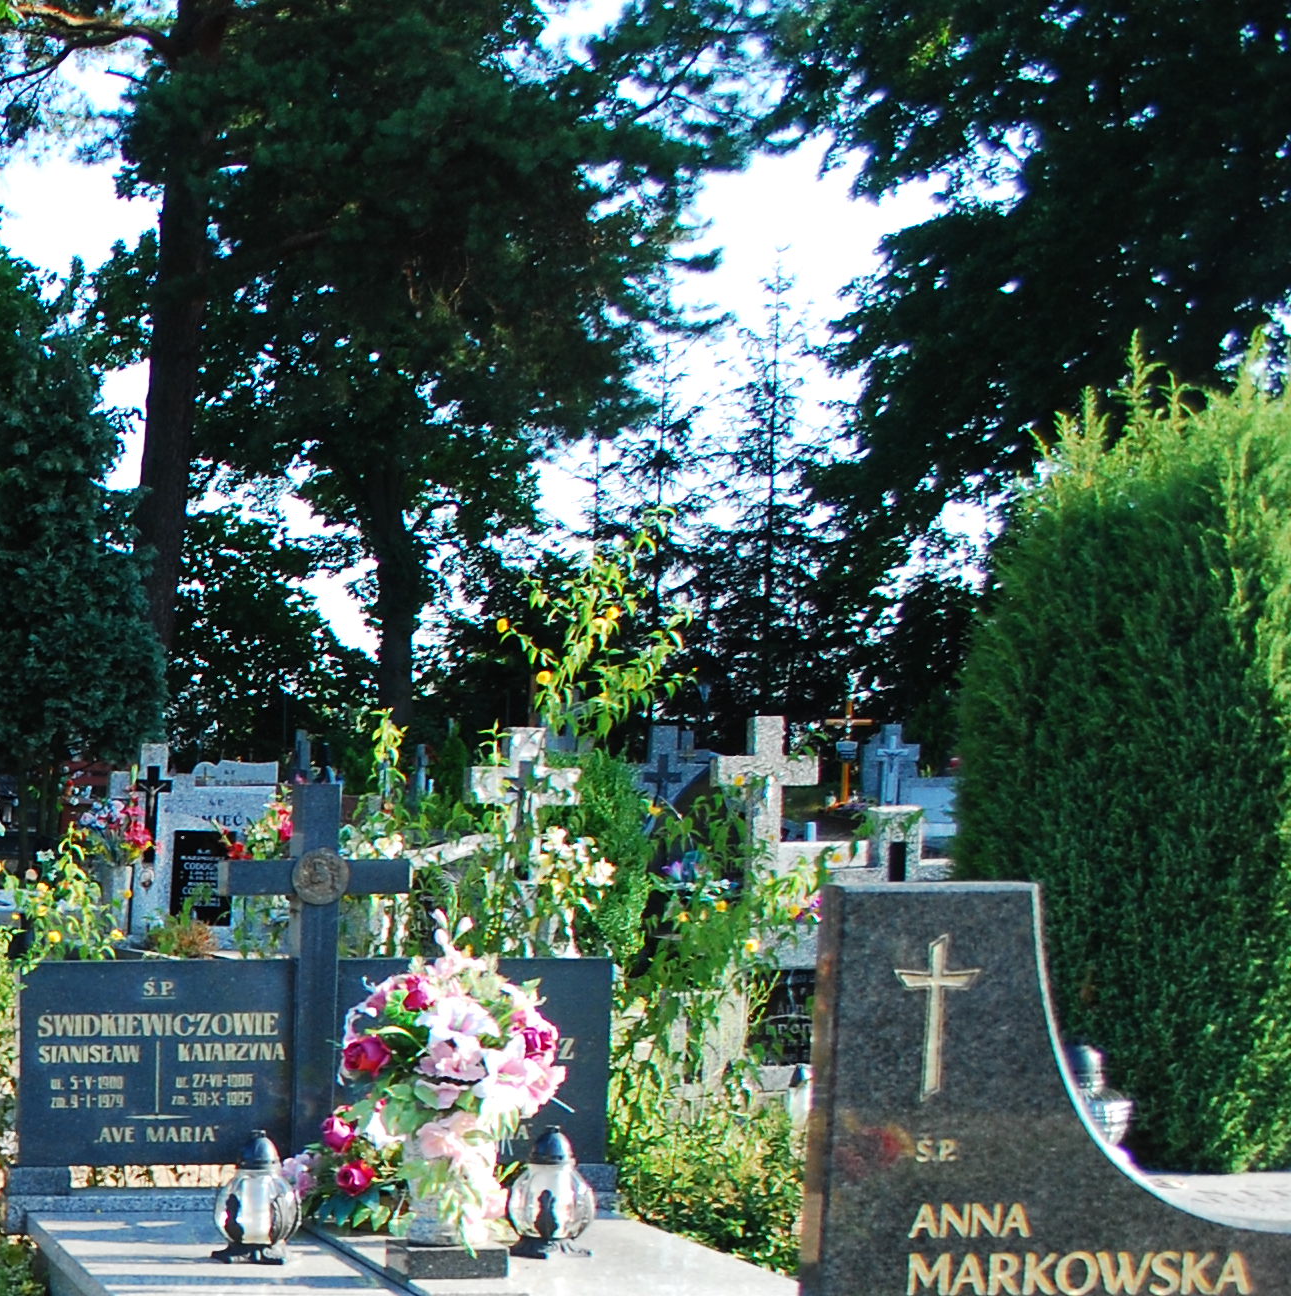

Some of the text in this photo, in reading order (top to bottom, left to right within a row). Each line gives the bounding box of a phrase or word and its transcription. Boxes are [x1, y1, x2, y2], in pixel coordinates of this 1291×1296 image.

[38, 1044, 140, 1064] STANISŁAW
[177, 1042, 287, 1062] KATARZYNA
[907, 1201, 1033, 1239] ANNA
[905, 1250, 1254, 1296] MARKOWSKA
